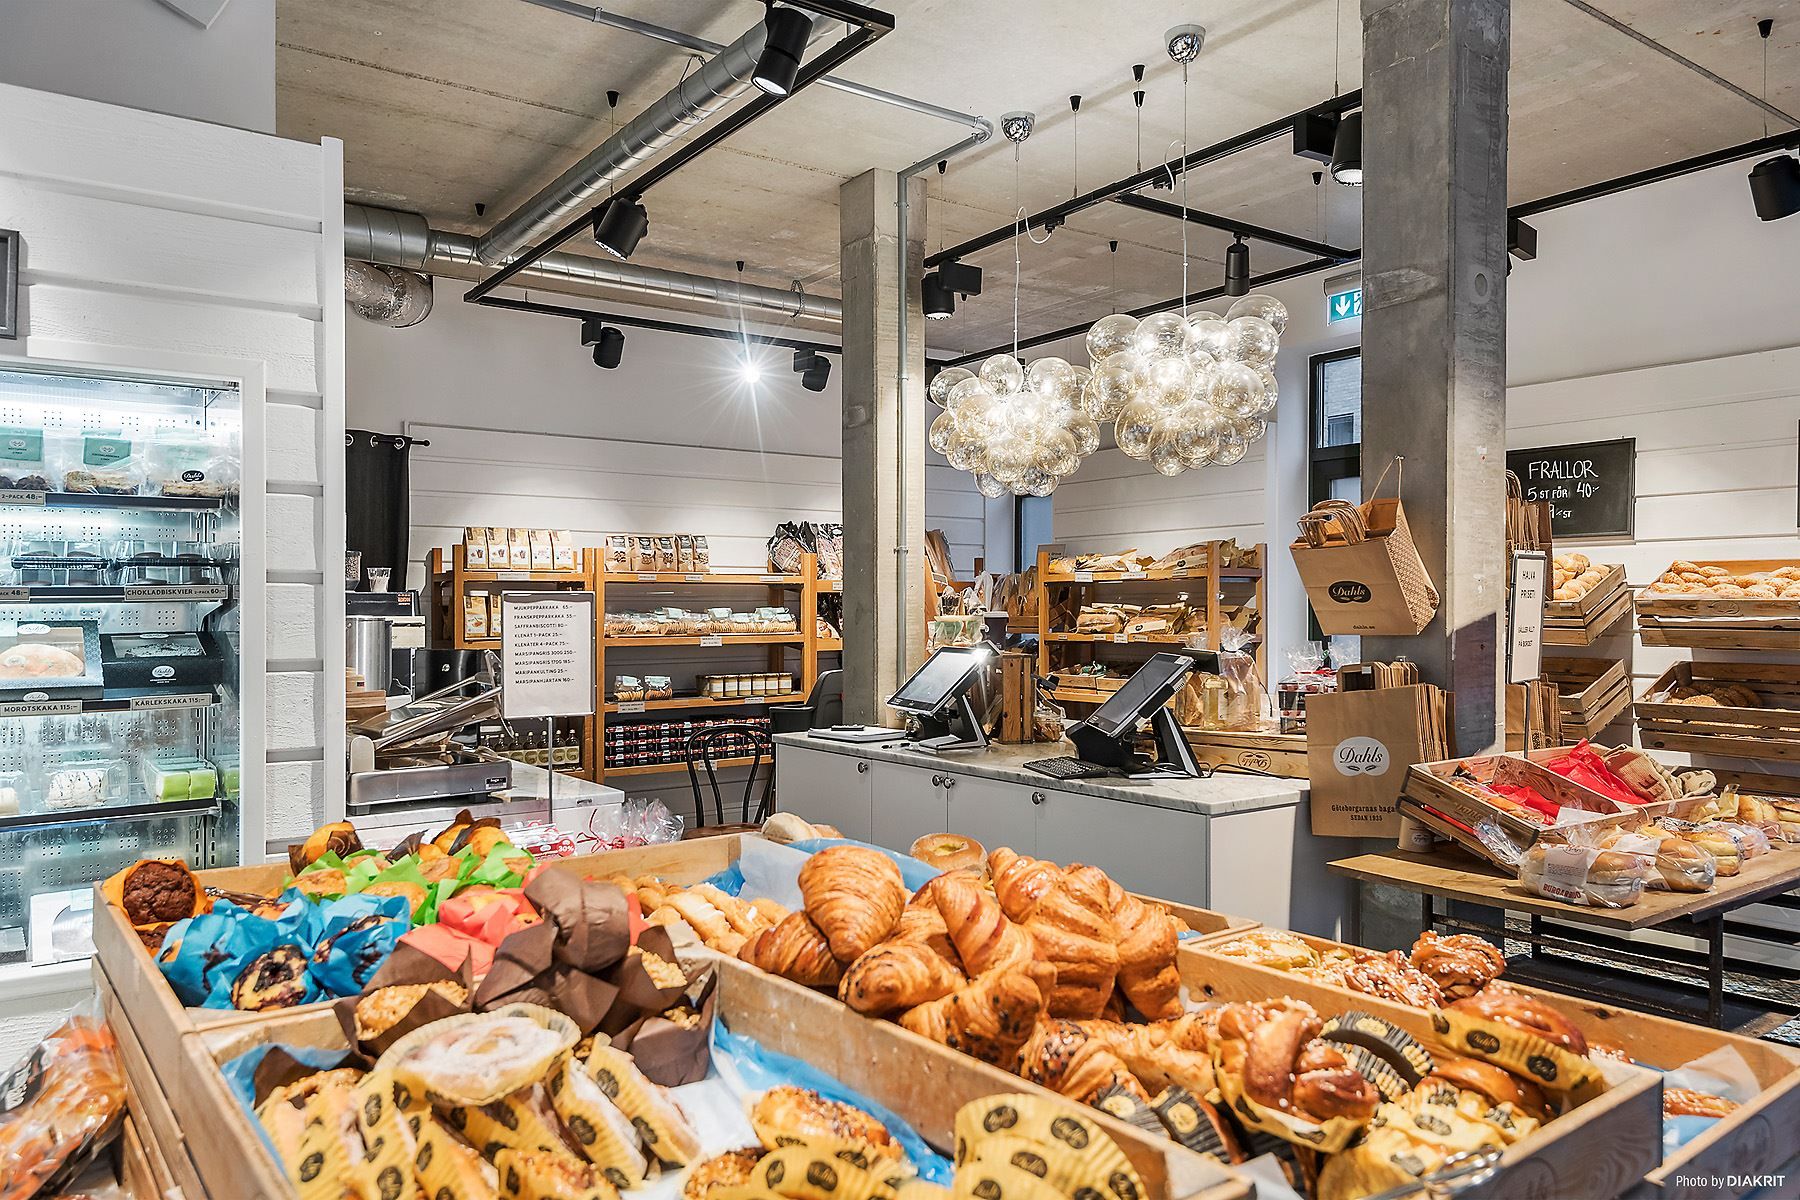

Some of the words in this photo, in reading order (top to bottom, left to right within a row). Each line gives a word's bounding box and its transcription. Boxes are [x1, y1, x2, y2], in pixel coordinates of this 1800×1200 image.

[1528, 460, 1599, 479] FRALLOR
[1527, 487, 1537, 501] 5
[1540, 490, 1549, 499] ST
[1552, 486, 1568, 499] FÖR
[127, 588, 193, 596] CHOKLADBISKVIER
[1332, 586, 1366, 596] Dahls
[4, 705, 58, 713] MOROTSKAKA
[1339, 746, 1383, 764] Dahls
[1331, 803, 1378, 814] Göteborgarnas
[1379, 804, 1396, 814] baga
